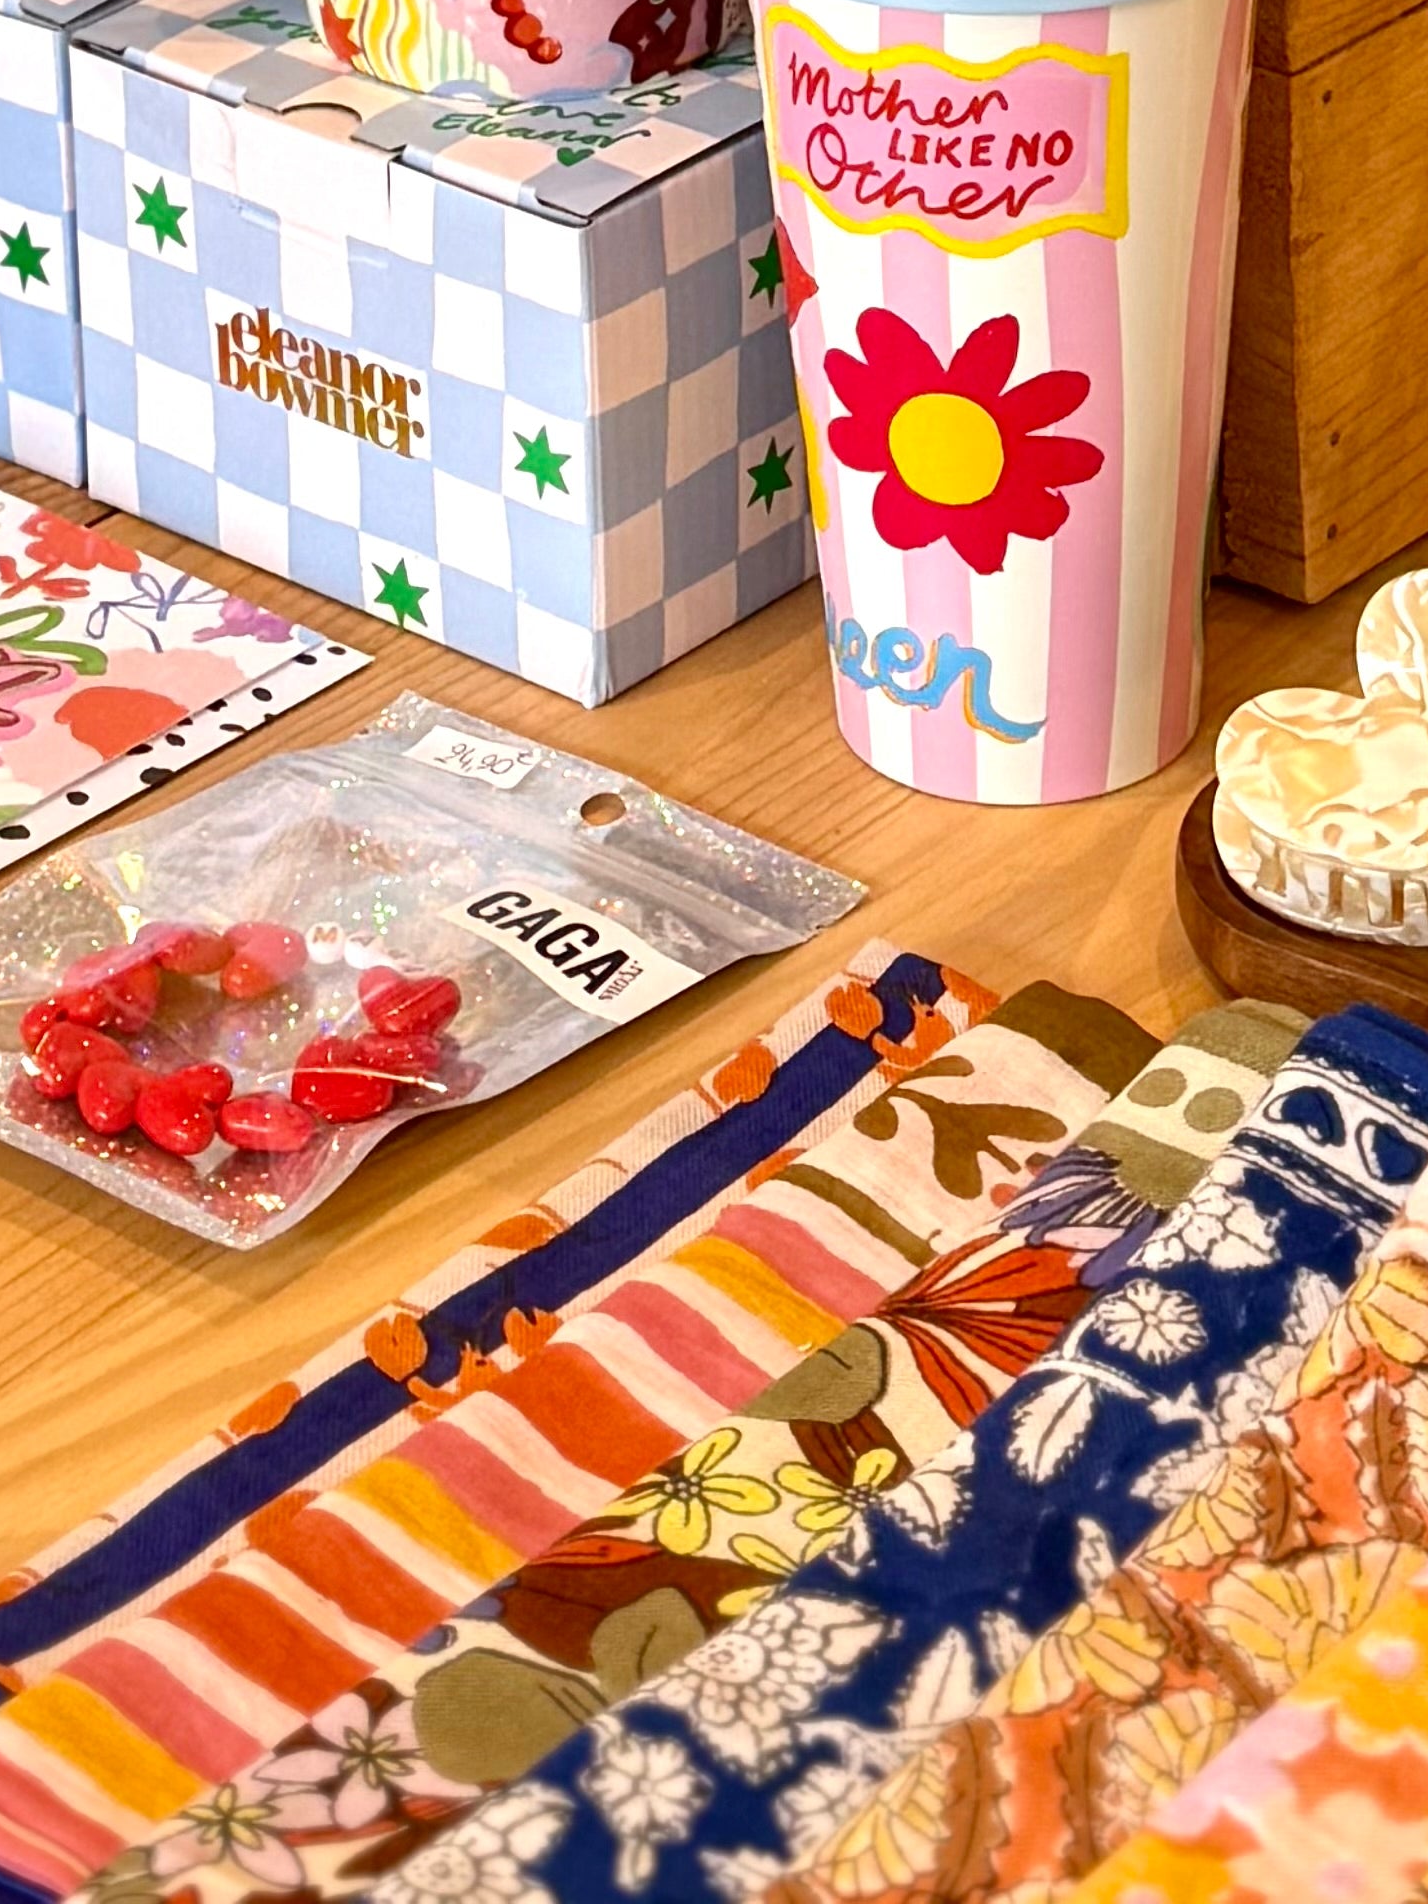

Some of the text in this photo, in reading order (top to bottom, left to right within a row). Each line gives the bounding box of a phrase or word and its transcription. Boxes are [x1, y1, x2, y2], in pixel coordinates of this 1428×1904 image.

[432, 112, 652, 149] Eleanor
[788, 51, 1010, 129] Mother
[805, 122, 1055, 221] Other
[887, 127, 1074, 171] LIKE NO
[214, 322, 425, 459] bowmer
[229, 306, 422, 418] eleanor
[467, 891, 631, 995] GAGA
